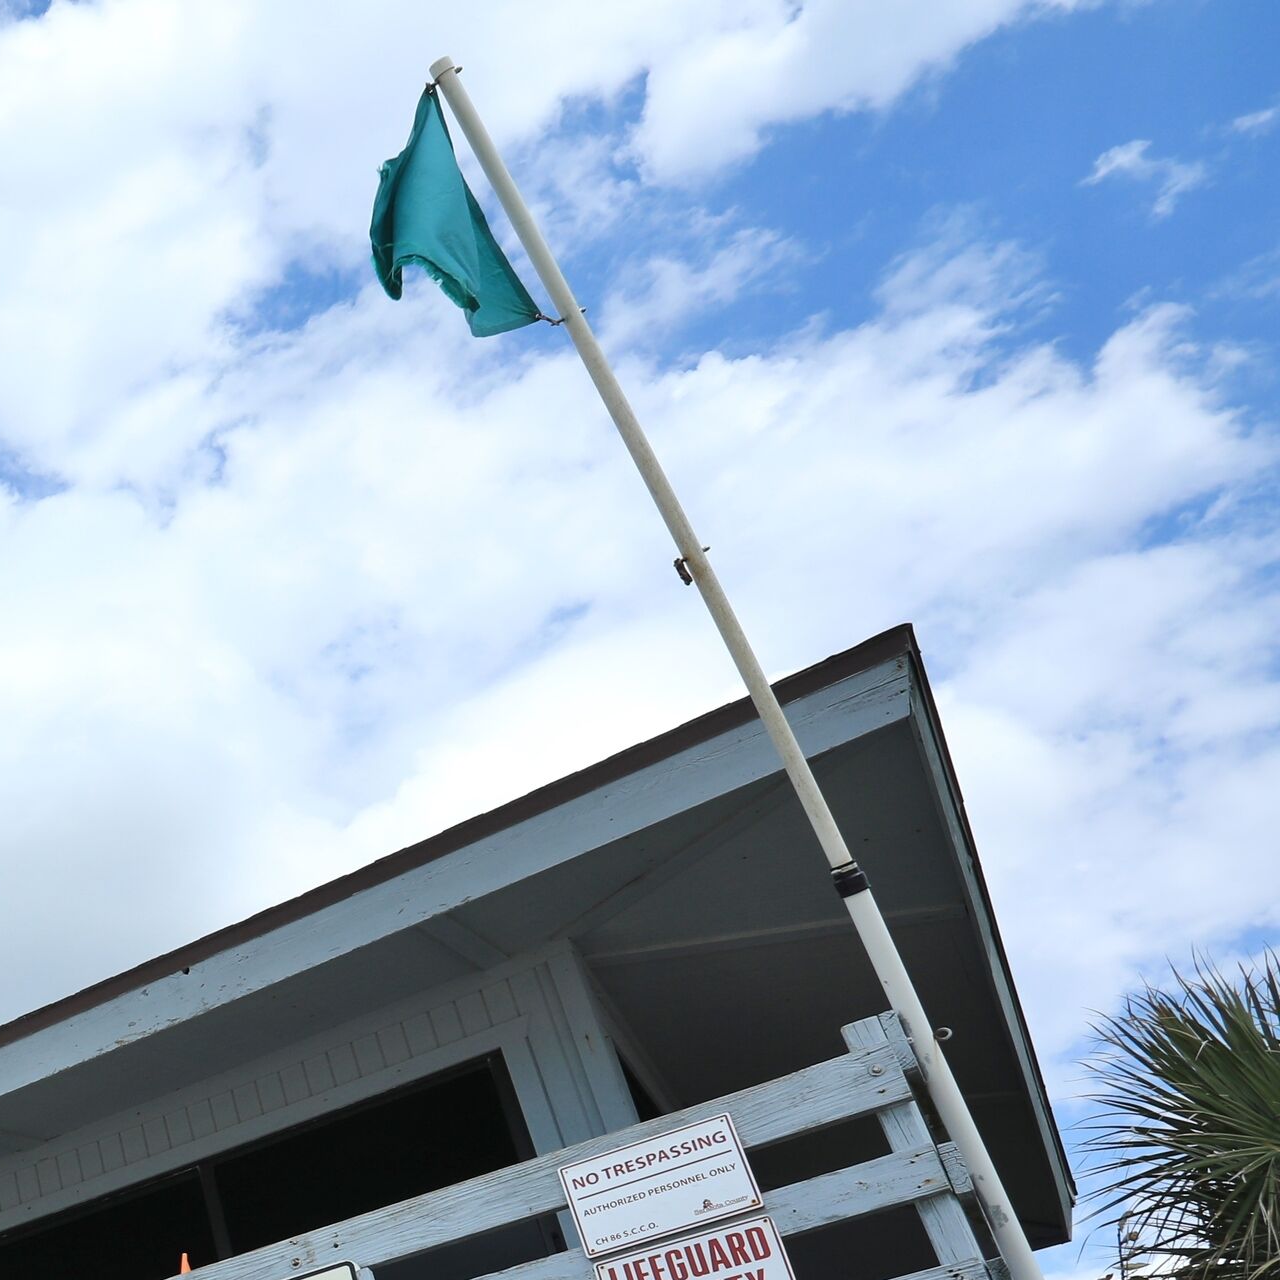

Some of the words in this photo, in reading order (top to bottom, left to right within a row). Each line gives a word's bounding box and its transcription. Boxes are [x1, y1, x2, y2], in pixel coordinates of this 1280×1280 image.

[572, 1172, 600, 1189] NO
[602, 1130, 727, 1180] TRESPASSING
[583, 1192, 646, 1217] AUTHORIZED
[648, 1173, 707, 1197] PERSONNEL
[709, 1163, 737, 1178] ONLY
[725, 1196, 748, 1205] County
[596, 1235, 608, 1246] CH
[610, 1231, 622, 1242] 86
[623, 1222, 659, 1238] S.C.C.O.
